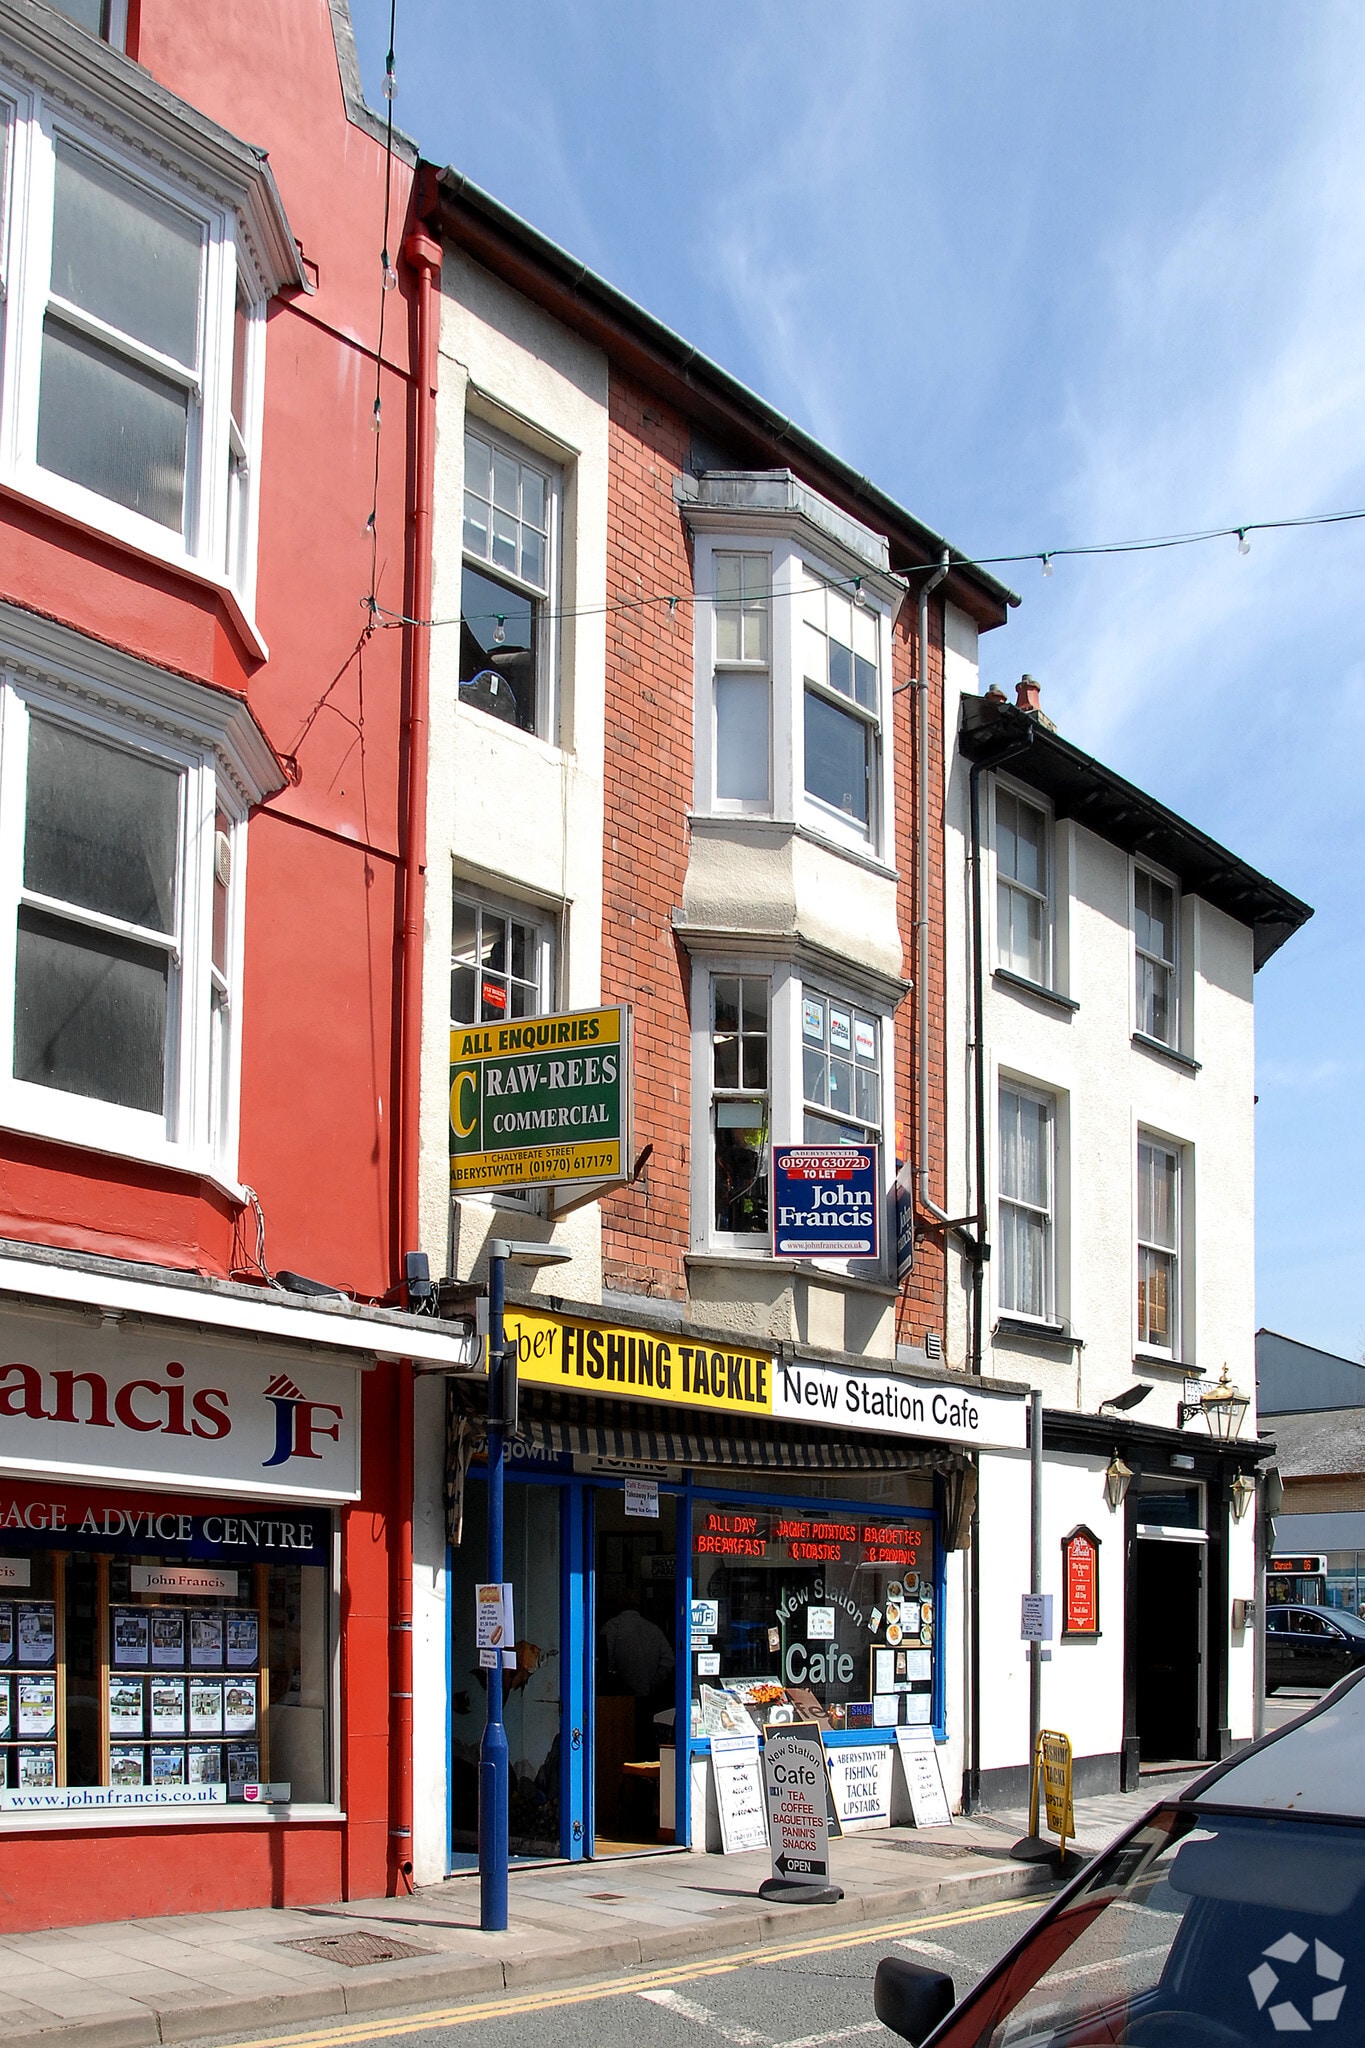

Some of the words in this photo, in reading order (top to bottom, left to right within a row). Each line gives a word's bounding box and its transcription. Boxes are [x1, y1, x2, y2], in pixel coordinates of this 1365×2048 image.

[461, 1033, 492, 1055] ALL
[499, 1018, 599, 1051] ENQUIRIES
[493, 1103, 610, 1134] COMMERCIAL
[491, 1151, 543, 1163] CHALYBEATE
[545, 1146, 576, 1157] STREET
[782, 1158, 820, 1168] 01970
[821, 1158, 866, 1168] 630721
[450, 1163, 522, 1181] ABERYSTWYTH
[530, 1158, 570, 1176] (01970)
[574, 1154, 612, 1170] 617179
[803, 1169, 816, 1178] TO
[818, 1169, 836, 1178] LET
[811, 1184, 873, 1210] John
[778, 1205, 873, 1227] Francis
[787, 1241, 863, 1250] www.johnfrancis.co.uk
[561, 1326, 672, 1389] FISHING
[678, 1347, 767, 1404] TACKLE
[783, 1368, 838, 1409] New
[845, 1379, 924, 1422] Station
[932, 1394, 979, 1429] Cafe
[77, 1506, 194, 1542] ADVICE
[202, 1516, 314, 1550] CENTRE
[709, 1514, 730, 1532] ALL
[734, 1516, 757, 1534] DAY
[812, 1522, 857, 1542] POTATOES
[698, 1535, 766, 1556] BREAKFAST
[864, 1527, 921, 1546] BAGUETTES
[792, 1543, 800, 1560] &
[802, 1543, 841, 1561] TOASTIES
[146, 1574, 176, 1587] John
[178, 1575, 225, 1588] Francis
[776, 1586, 808, 1626] New
[814, 1578, 863, 1627] Station
[785, 1643, 854, 1684] Cafe
[768, 1747, 786, 1766] New
[788, 1744, 820, 1768] Station
[837, 1750, 886, 1764] ABERYSTWYTH
[774, 1764, 816, 1785] Cafe
[845, 1764, 878, 1780] FISHING
[11, 1787, 218, 1809] www.johnfrancis.co.uk
[788, 1790, 806, 1802] TEA
[846, 1782, 877, 1798] TACKLE
[780, 1802, 814, 1814] COFFEE
[844, 1798, 880, 1814] UPSTAIRS
[773, 1814, 824, 1828] BAGUETTES
[782, 1826, 816, 1839] PANINI'S
[782, 1838, 816, 1851] SNACKS
[787, 1860, 811, 1872] OPEN
